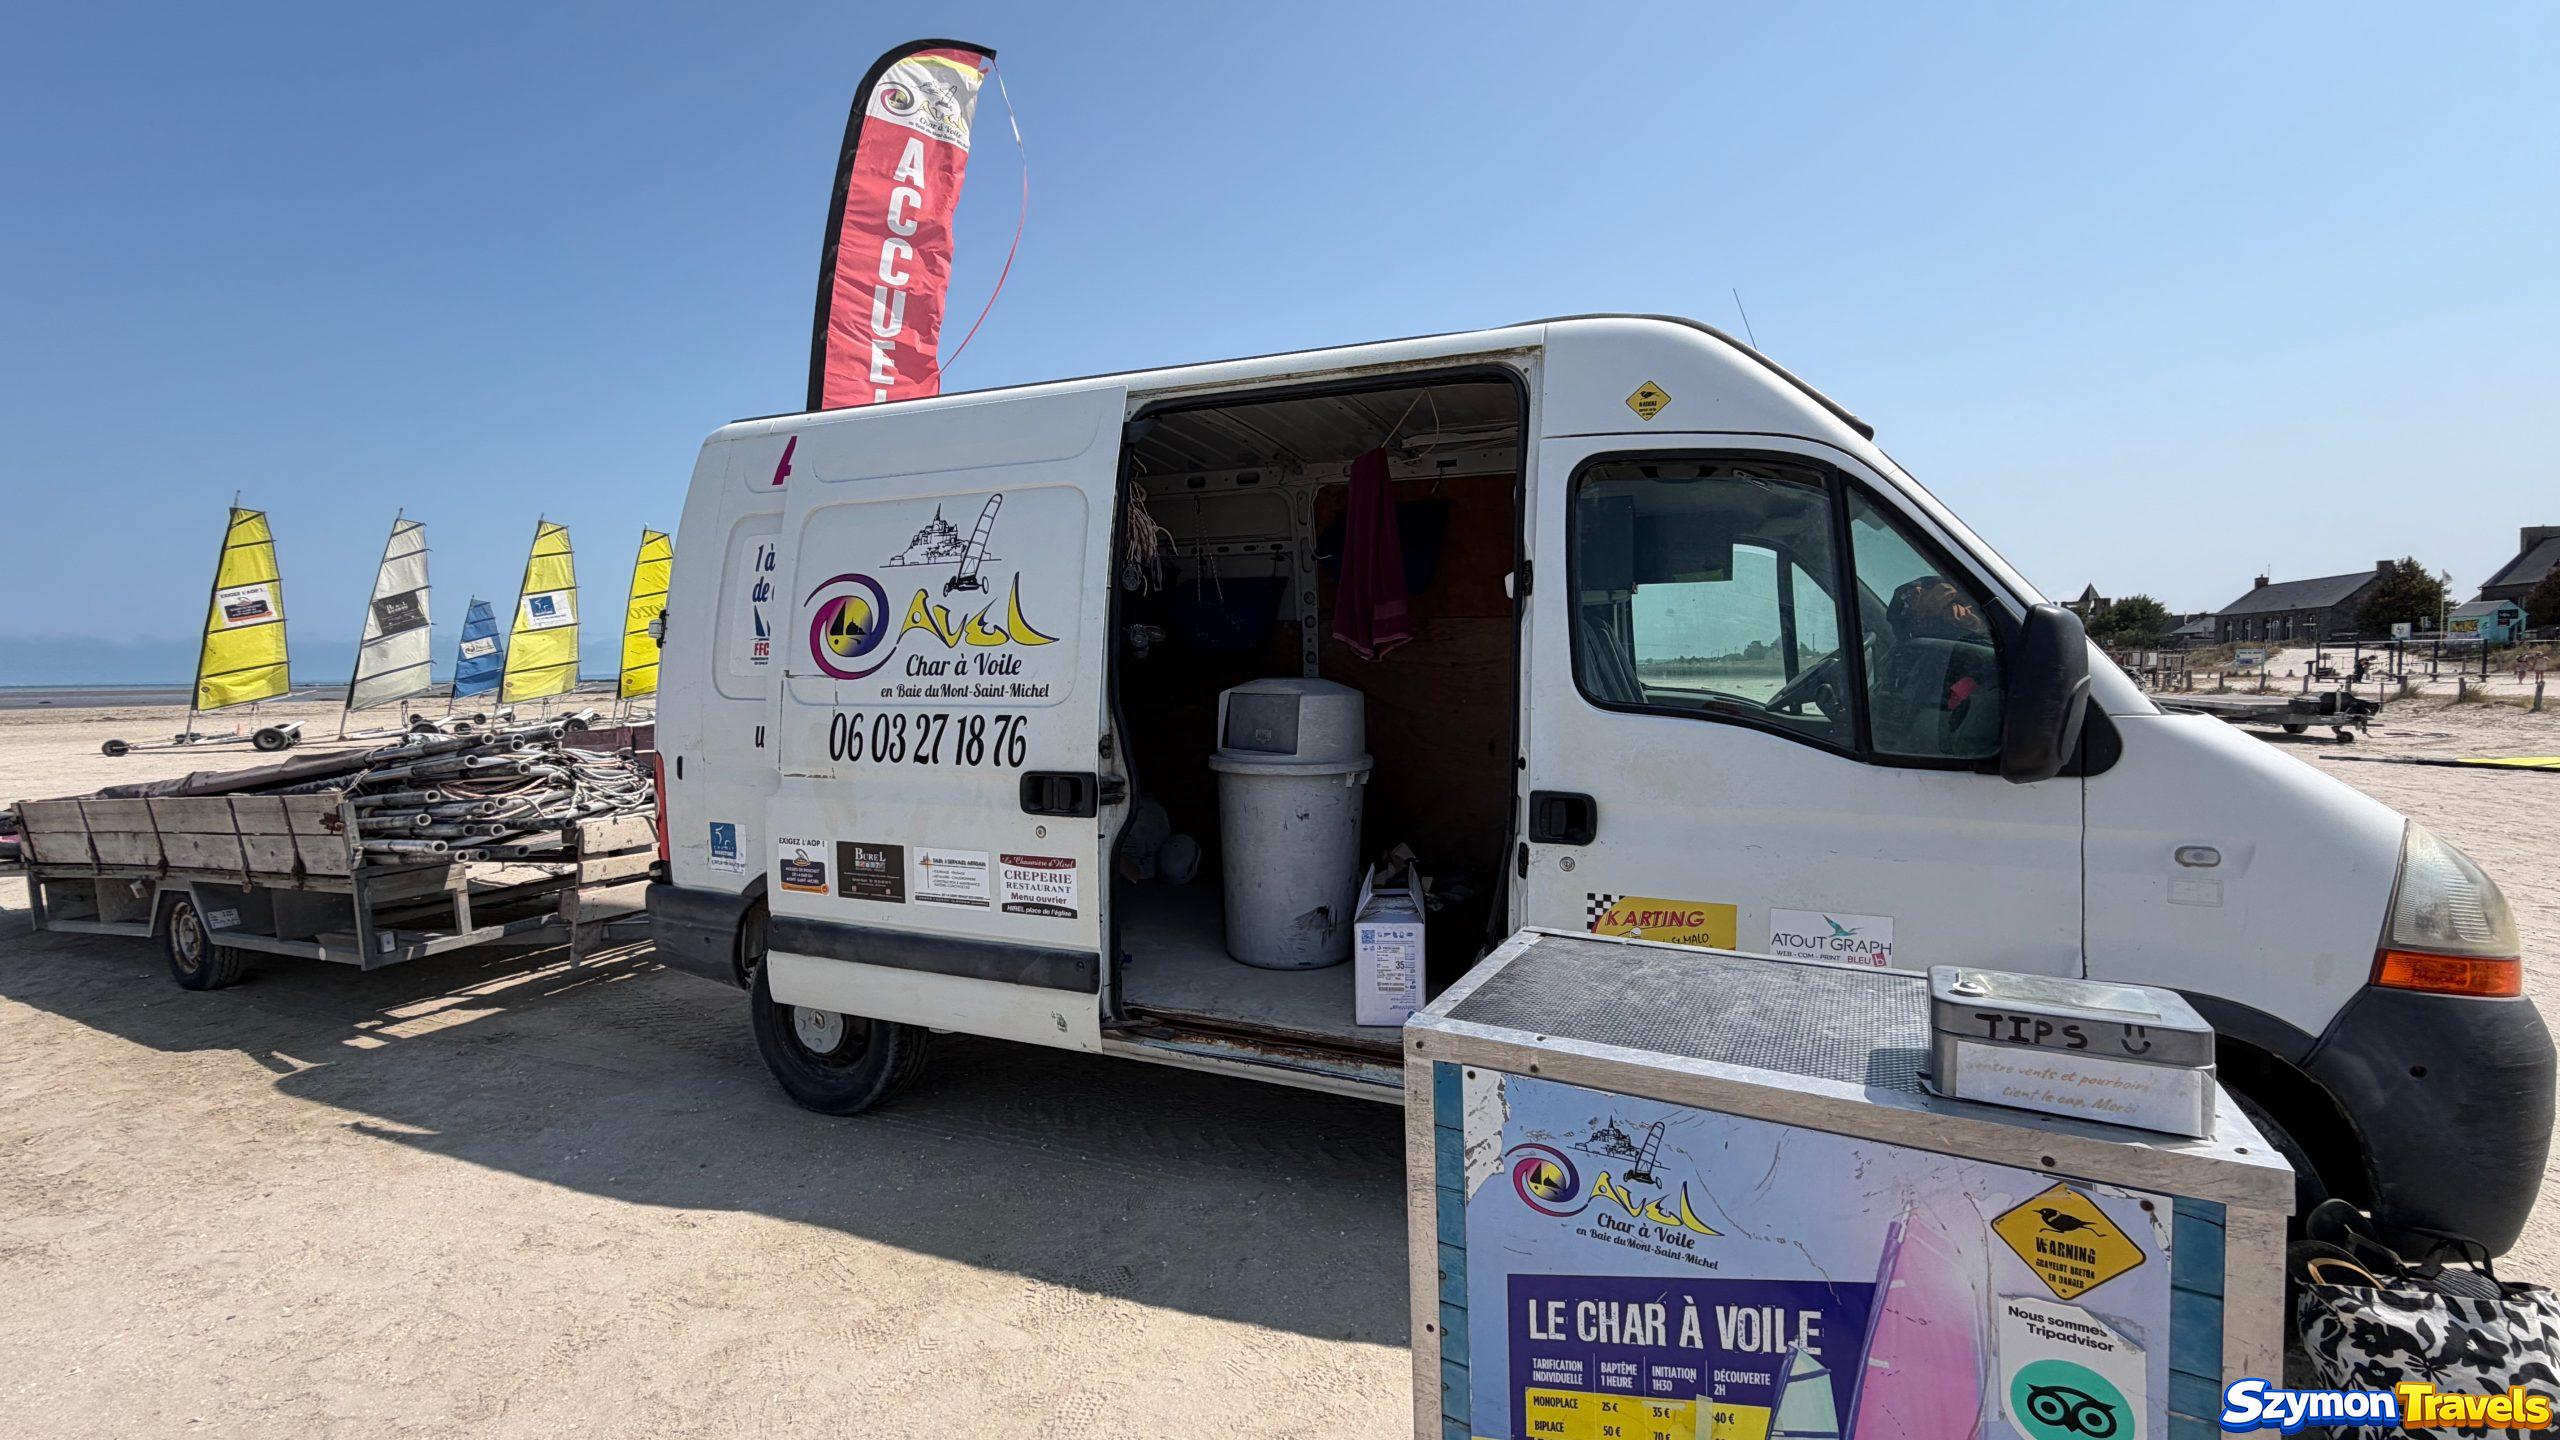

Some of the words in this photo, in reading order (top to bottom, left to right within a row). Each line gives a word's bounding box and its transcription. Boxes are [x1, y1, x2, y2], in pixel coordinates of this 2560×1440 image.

[869, 136, 925, 403] ACCUE
[756, 544, 764, 572] 1
[752, 576, 770, 602] de
[906, 654, 950, 677] Char
[954, 653, 968, 676] à
[974, 653, 1022, 676] Voile
[881, 686, 893, 698] en
[896, 684, 921, 698] Baie
[925, 684, 939, 698] du
[940, 683, 1049, 698] Mont-Saint-Michel
[829, 713, 864, 762] 06
[871, 713, 906, 763] 03
[913, 714, 949, 765] 27
[955, 714, 985, 766] 18
[993, 714, 1028, 768] 76
[779, 837, 800, 846] EXIGEZ
[1004, 869, 1072, 884] CREPERIE
[1006, 881, 1071, 894] RESTAURANT
[1011, 892, 1034, 902] Menu
[1036, 896, 1067, 905] ouvrier
[1026, 907, 1041, 915] place
[1771, 932, 1827, 949] ATOUT
[1830, 938, 1892, 956] GRAPH
[1847, 956, 1871, 965] BLEU
[1975, 1013, 2088, 1049] TIPS
[2061, 1072, 2077, 1082] et
[1597, 1212, 1635, 1235] Char
[1638, 1222, 1651, 1238] à
[1654, 1226, 1695, 1250] Voile
[1576, 1228, 1587, 1236] en
[1590, 1228, 1612, 1243] Baie
[1613, 1236, 1627, 1246] du
[1627, 1238, 1719, 1271] Mont-Saint-Michel
[2036, 1236, 2096, 1265] WARNING
[1528, 1299, 1567, 1341] LE
[1577, 1300, 1667, 1347] CHAR
[1679, 1295, 1704, 1349] À
[1716, 1304, 1823, 1355] VOILE
[2008, 1305, 2045, 1323] Nous
[2047, 1316, 2107, 1337] sommes
[2027, 1322, 2115, 1352] Tripadvisor
[1532, 1358, 1583, 1372] TARIFICATION
[1601, 1361, 1638, 1375] BAPTÊME
[1652, 1366, 1697, 1381] INITIATION
[1533, 1371, 1583, 1385] INDIVIDUELLE
[1606, 1376, 1633, 1388] HEURE
[1652, 1379, 1672, 1391] 1H30
[1714, 1368, 1771, 1385] DÉCOUVERTE
[1714, 1384, 1725, 1396] 2H
[1533, 1396, 1579, 1409] MONOPLACE
[1602, 1402, 1611, 1412] 25
[1652, 1407, 1662, 1418] 35
[1714, 1412, 1726, 1424] 40
[1728, 1413, 1735, 1424] €
[1534, 1420, 1564, 1433] BIPLACE
[1603, 1426, 1613, 1437] 50
